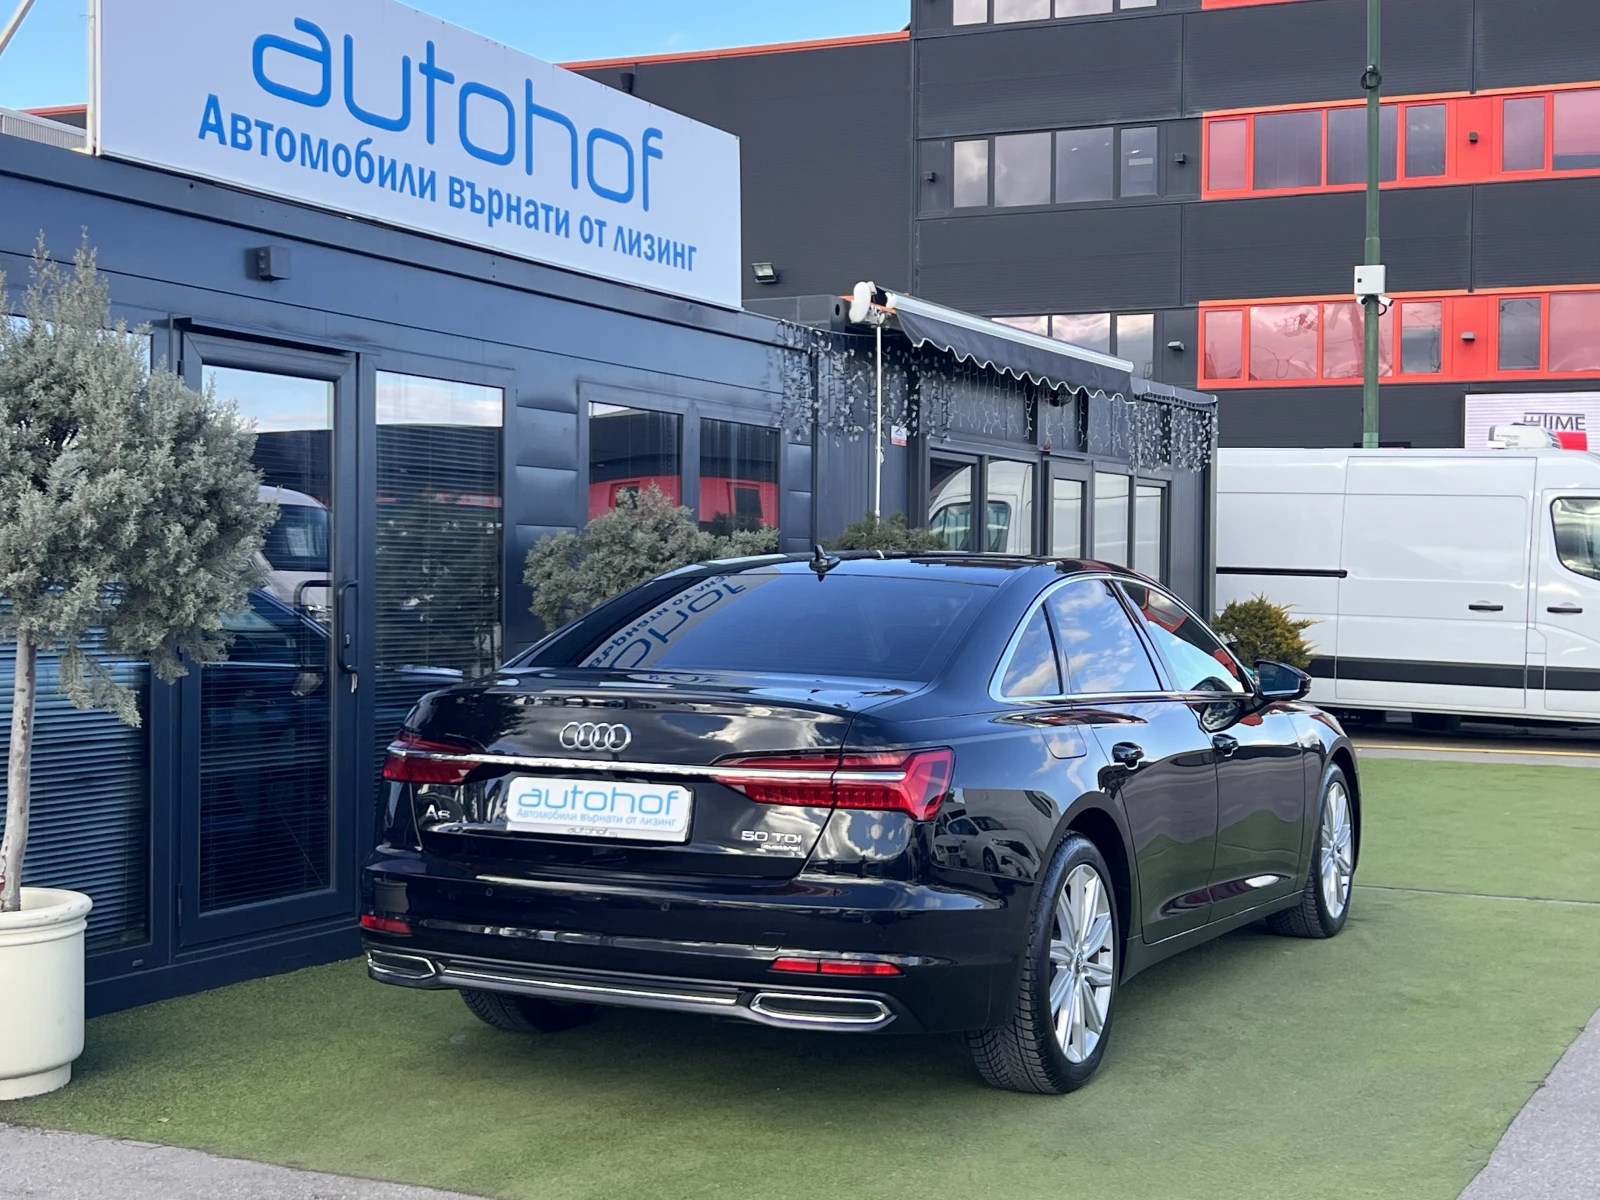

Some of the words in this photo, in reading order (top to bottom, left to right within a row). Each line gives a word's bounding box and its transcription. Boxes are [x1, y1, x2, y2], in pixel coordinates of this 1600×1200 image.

[252, 16, 663, 212] autohof
[198, 93, 436, 202] Автомобили
[449, 175, 570, 238] върнати
[579, 215, 607, 248] от
[613, 225, 697, 271] лизинг
[517, 785, 680, 815] autohof
[516, 807, 578, 822] Автомобили
[580, 814, 623, 825] върнати
[625, 816, 637, 825] от
[639, 817, 677, 828] лизинг
[741, 830, 769, 841] 50
[771, 832, 803, 844] TDI
